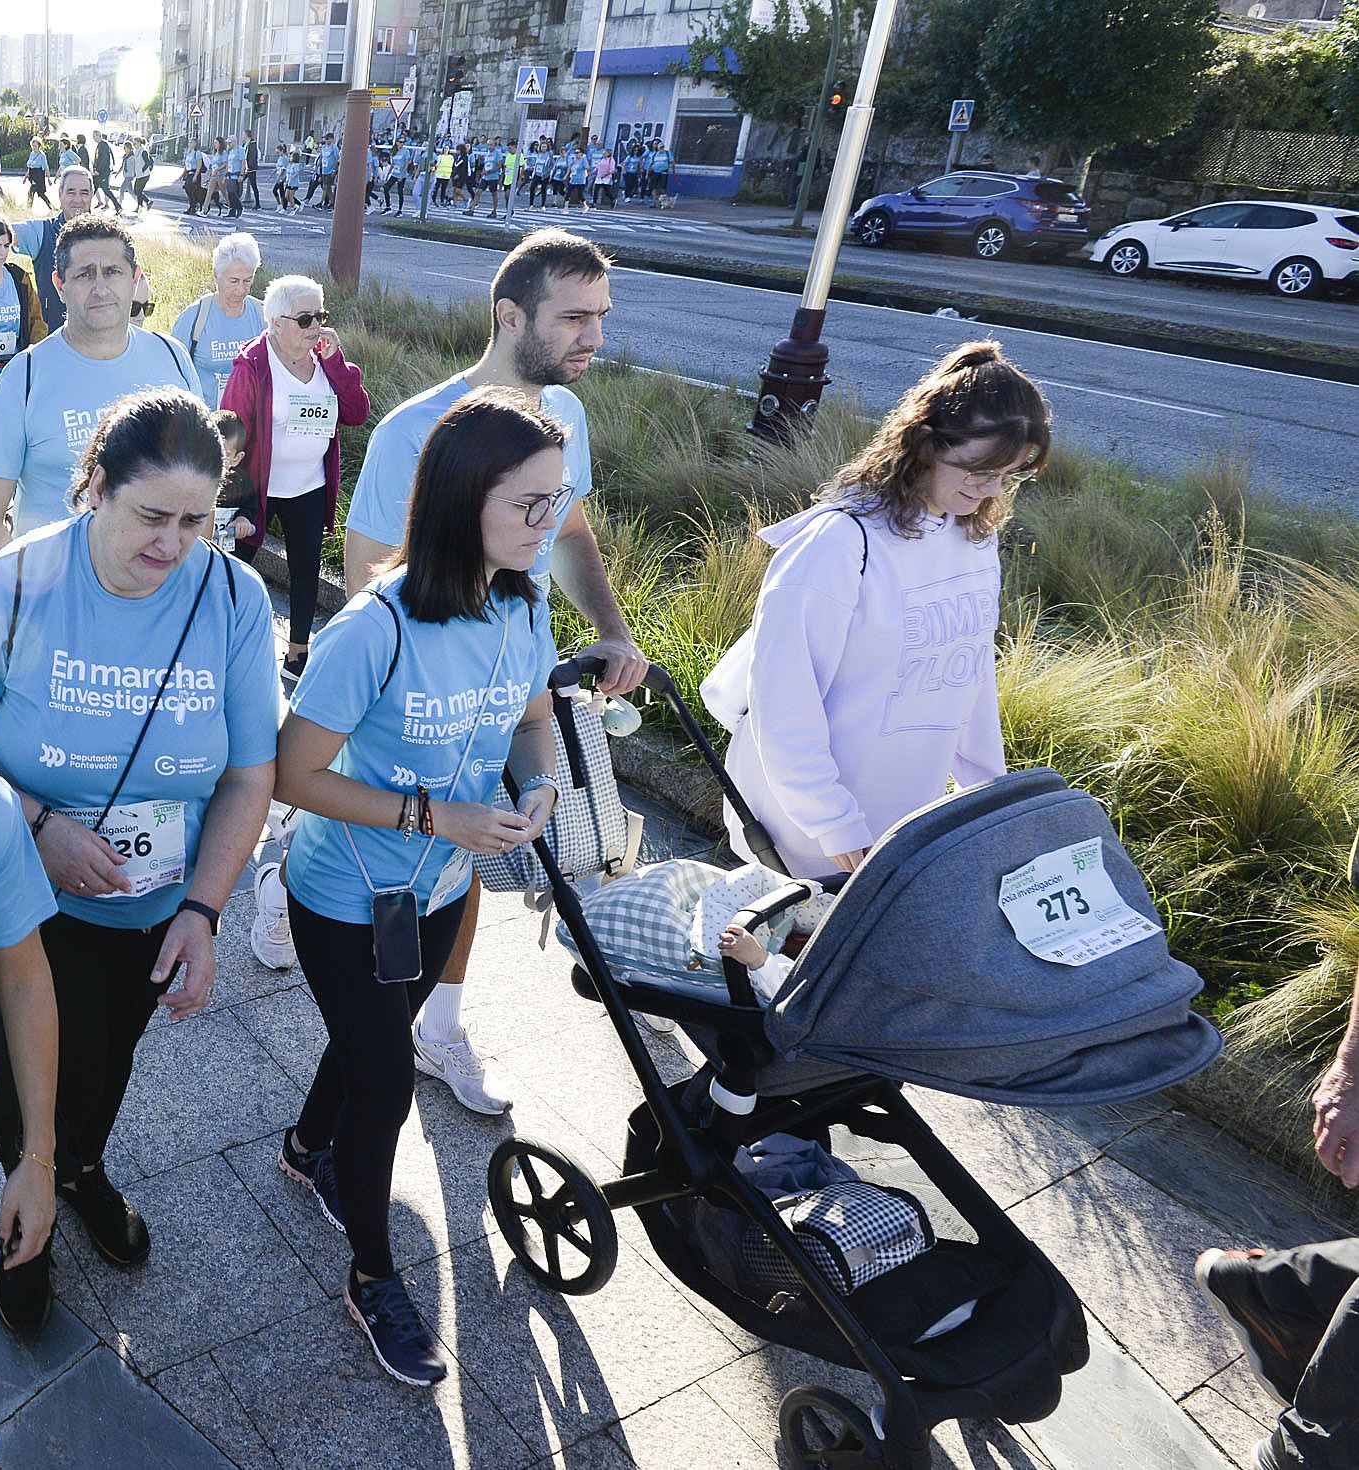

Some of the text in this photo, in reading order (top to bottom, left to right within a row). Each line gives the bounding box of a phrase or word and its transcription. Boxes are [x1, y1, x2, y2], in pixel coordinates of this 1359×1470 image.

[211, 341, 226, 351] En
[63, 409, 91, 428] En
[300, 407, 329, 418] 2062
[52, 649, 216, 691] En marcha
[404, 679, 530, 718] En marcha
[48, 701, 74, 713] contra
[82, 706, 112, 718] cancro
[69, 760, 118, 770] Pontevedra
[70, 753, 118, 763] Deputación
[1036, 887, 1091, 923] 273
